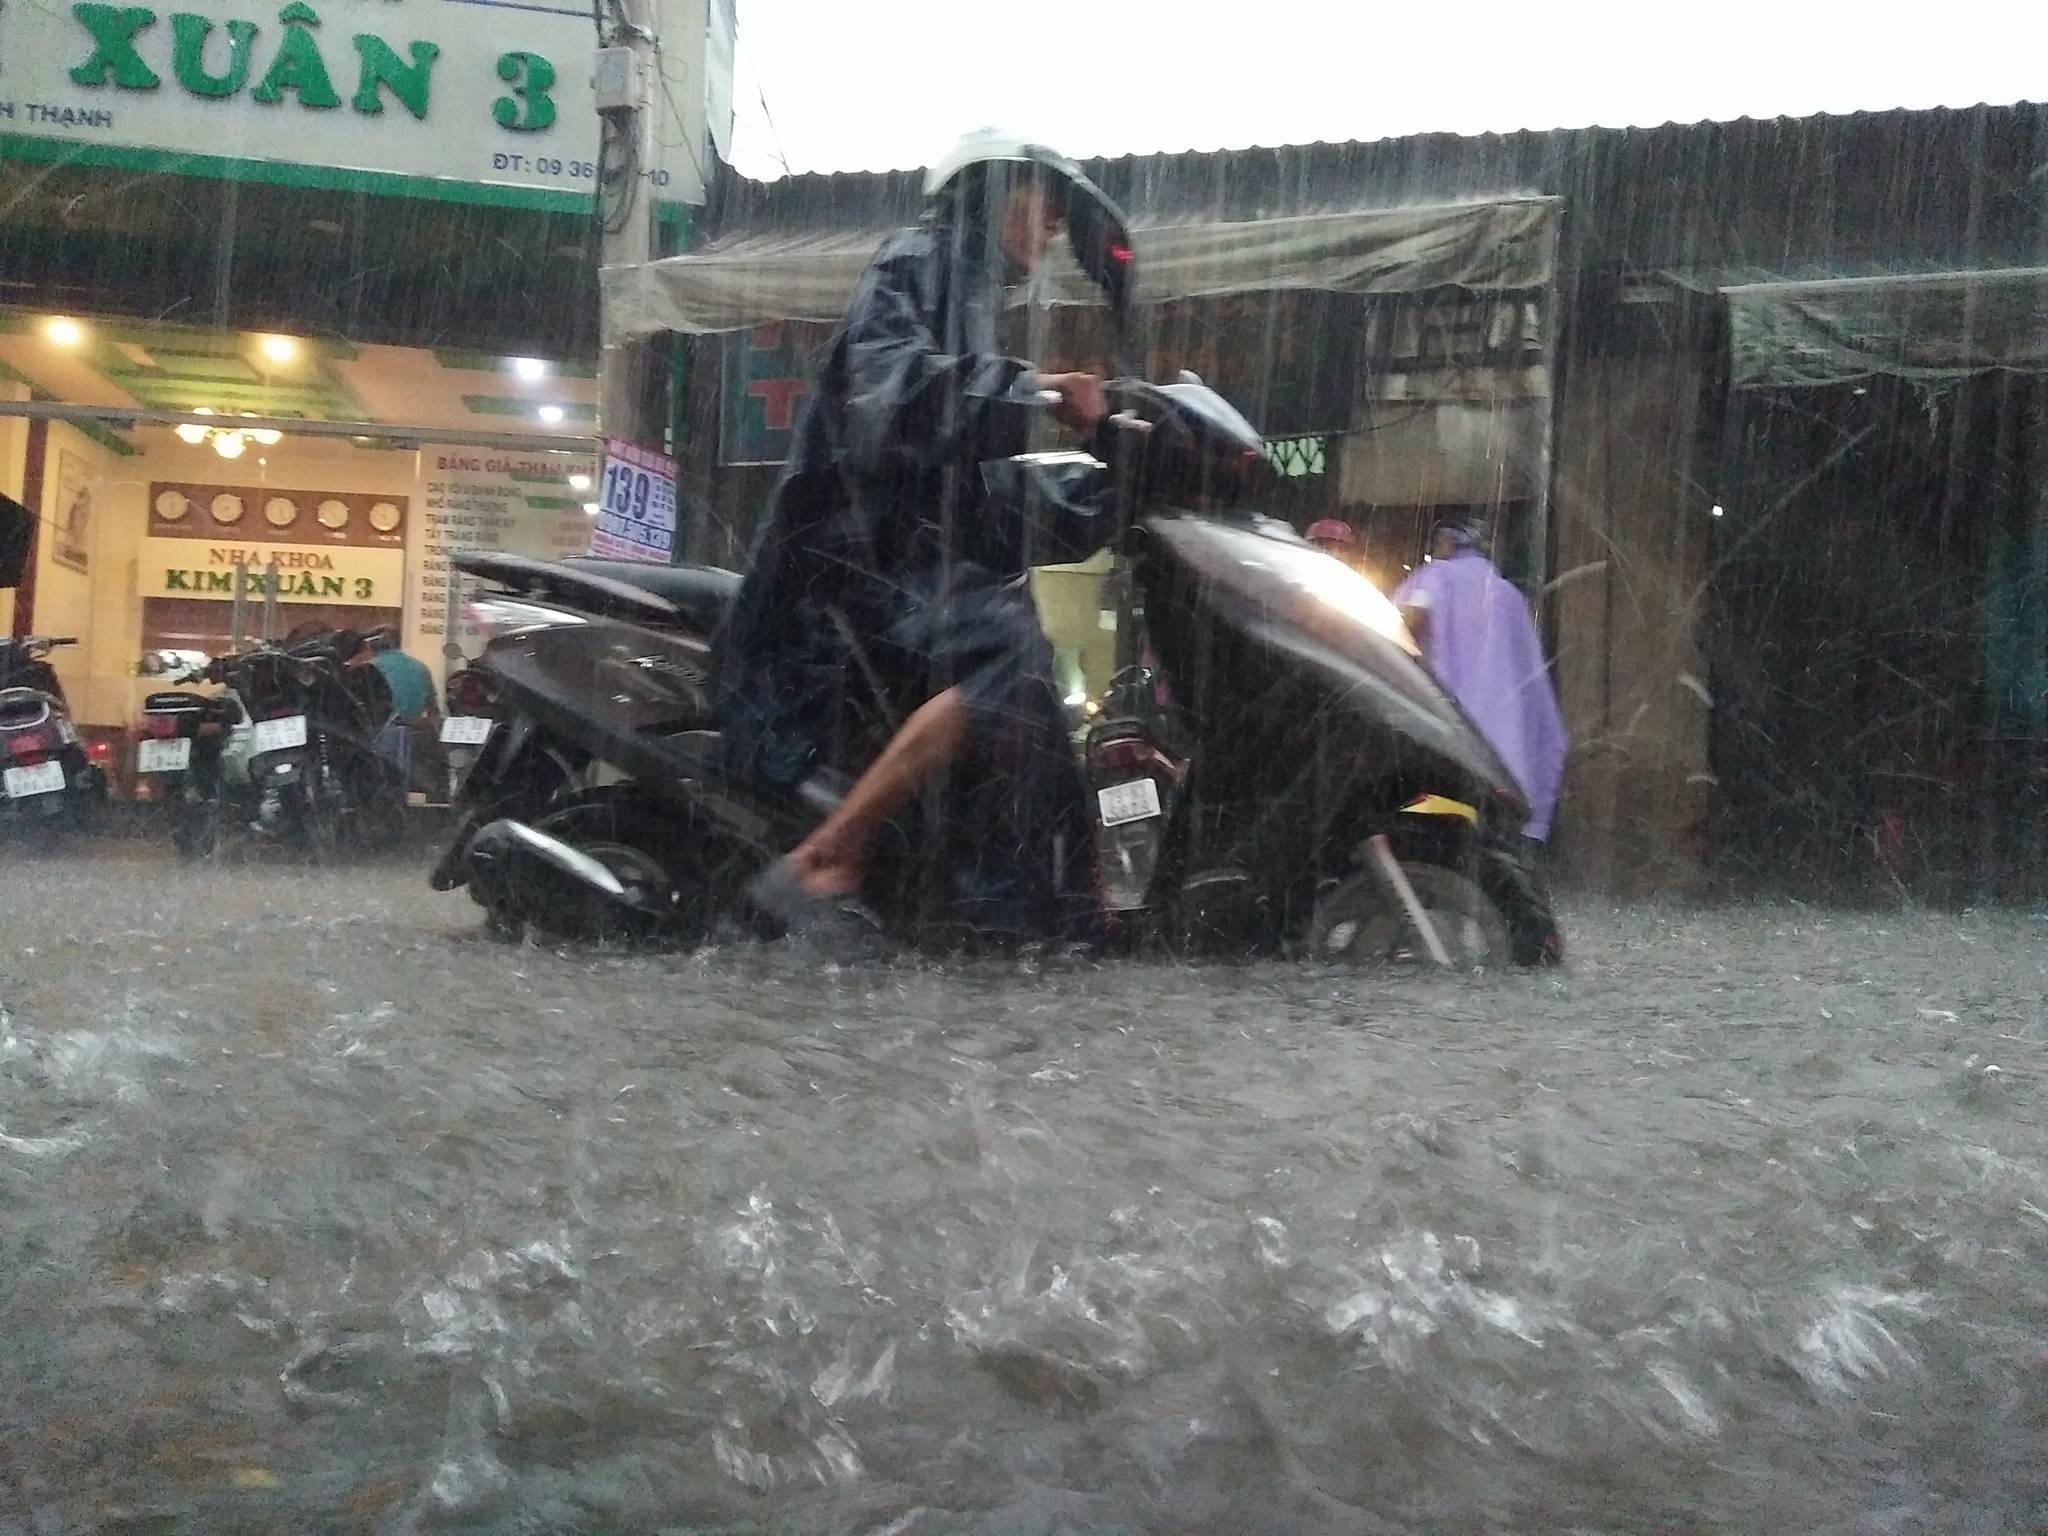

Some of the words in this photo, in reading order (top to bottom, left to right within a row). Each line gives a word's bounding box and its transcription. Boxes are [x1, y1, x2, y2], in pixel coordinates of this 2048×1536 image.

[69, 1, 440, 120] XUÂN
[492, 52, 557, 131] 3
[492, 153, 532, 174] ĐT:
[537, 157, 562, 176] 09
[606, 464, 650, 519] 139
[209, 548, 262, 566] NHA
[269, 551, 335, 571] KHOA
[166, 568, 233, 592] KIM
[246, 570, 346, 597] XUÂN
[354, 577, 374, 599] 3
